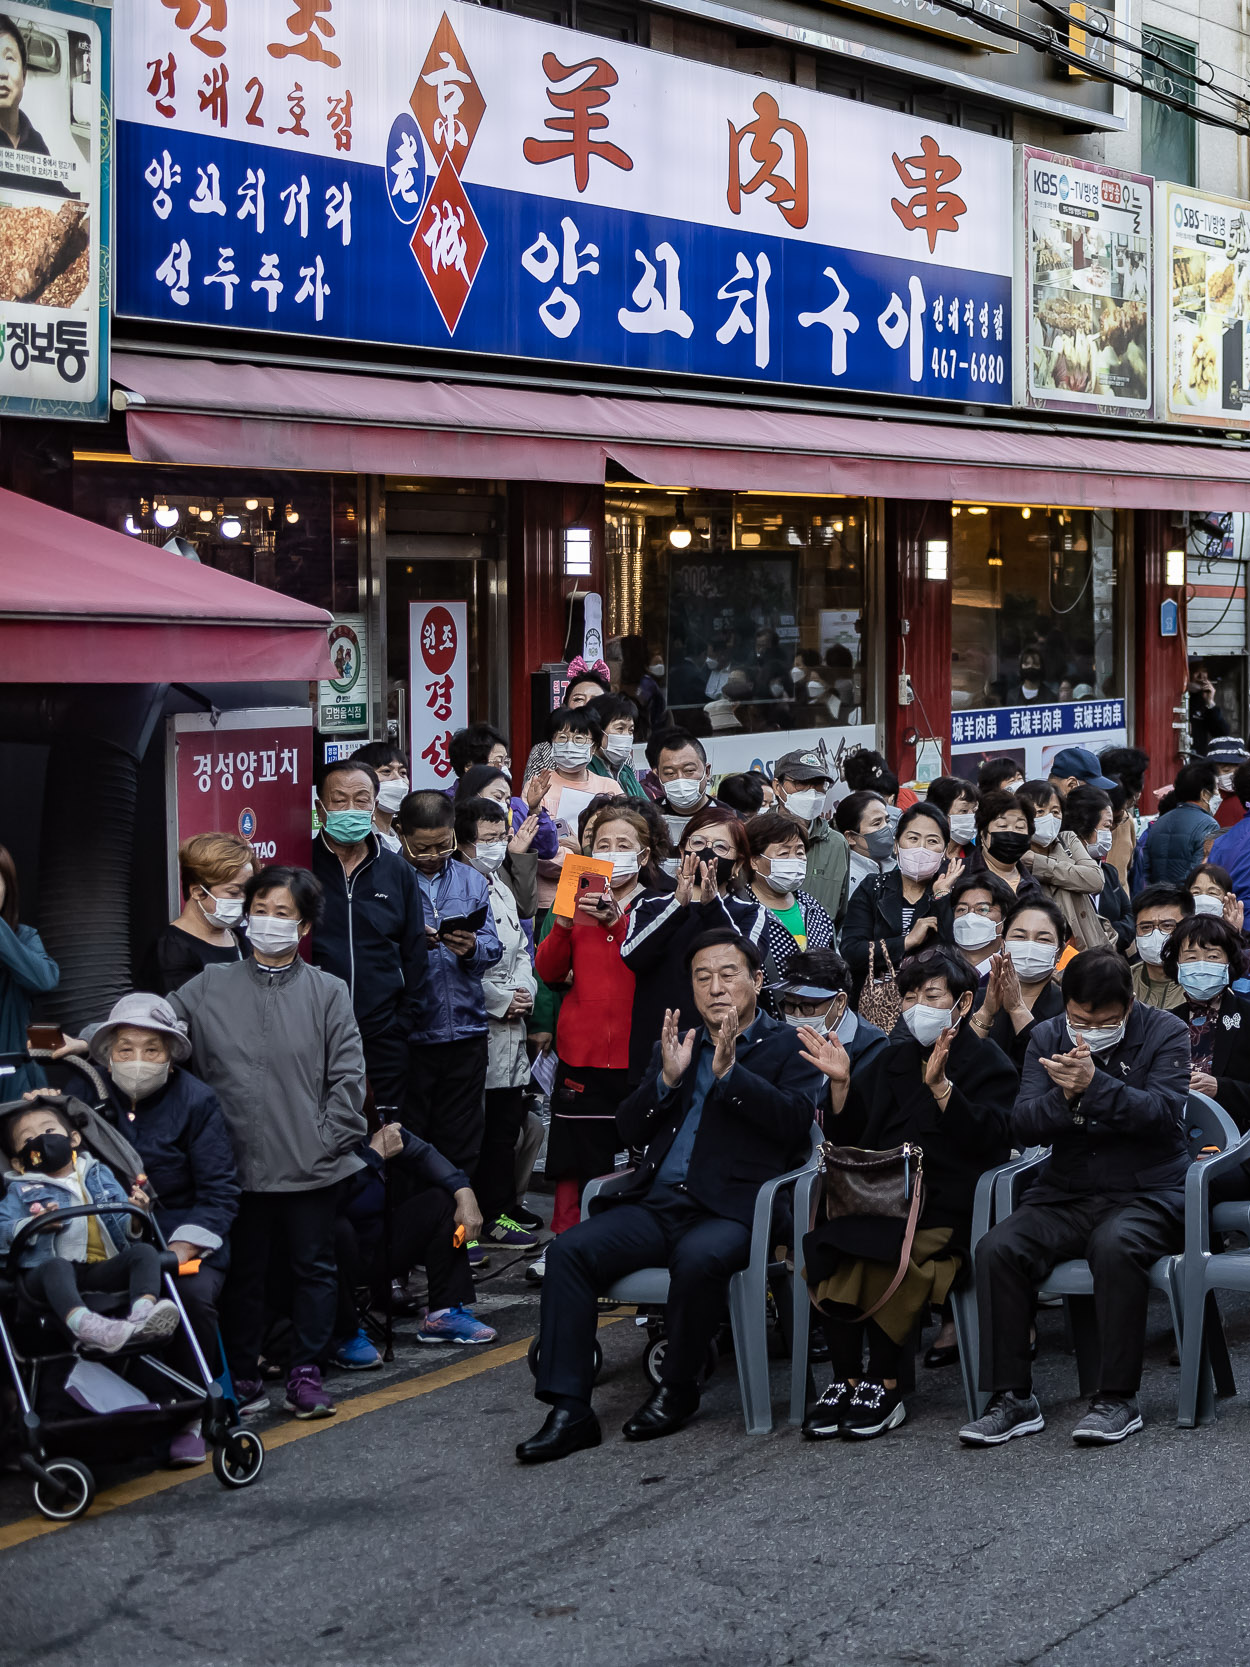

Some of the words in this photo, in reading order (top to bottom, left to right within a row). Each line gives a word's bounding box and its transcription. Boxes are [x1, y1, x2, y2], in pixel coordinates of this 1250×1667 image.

[523, 52, 967, 254] 羊肉串
[144, 149, 352, 246] 양꼬치거리
[1034, 169, 1058, 196] KBS
[1184, 208, 1199, 229] SBS
[521, 217, 924, 382] 양꼬치구이
[931, 347, 1003, 384] 467-6880
[423, 622, 453, 655] 원조
[326, 706, 361, 720] 모범음식점
[952, 714, 997, 742] 城羊肉串
[1010, 708, 1062, 736] 京城羊肉串
[1073, 703, 1122, 730] 京城羊肉串
[193, 749, 298, 792] 경성양꼬치
[248, 841, 276, 859] TAO
